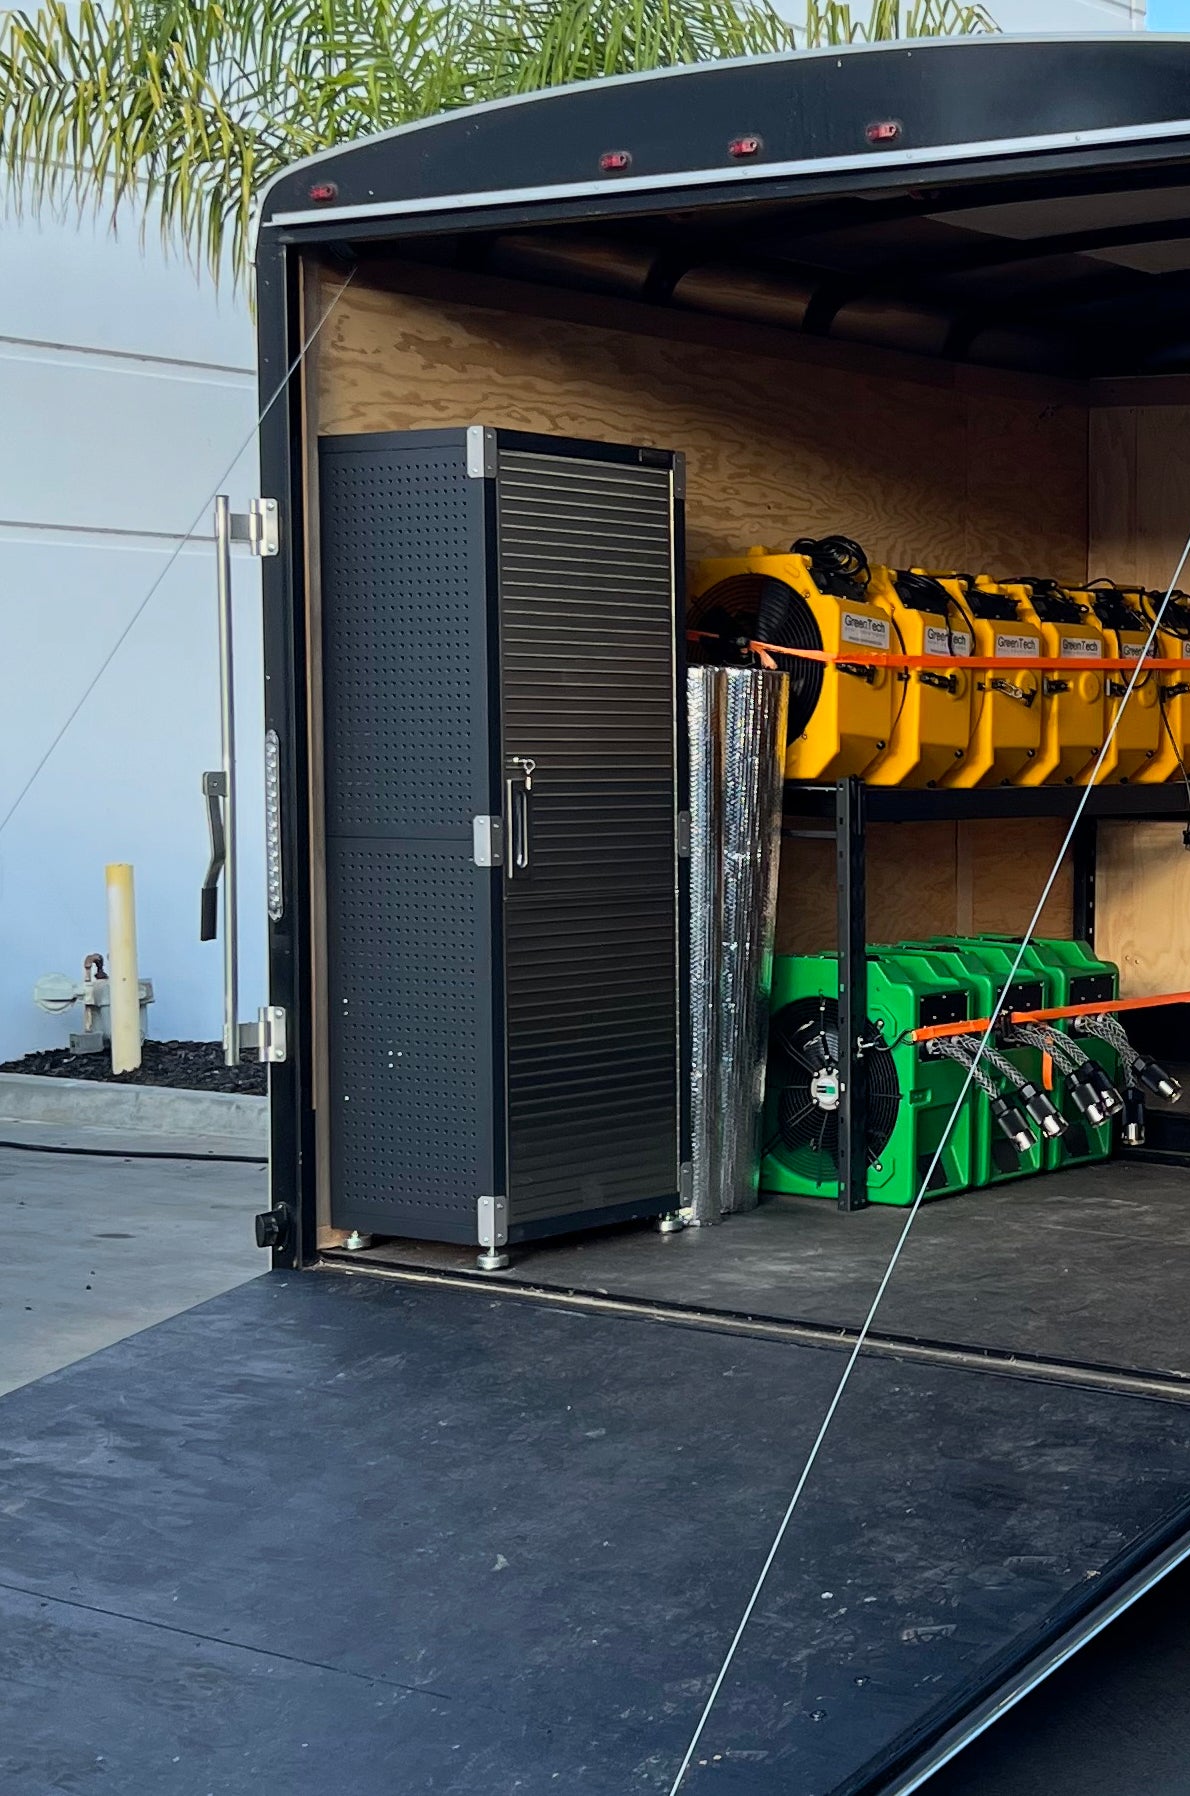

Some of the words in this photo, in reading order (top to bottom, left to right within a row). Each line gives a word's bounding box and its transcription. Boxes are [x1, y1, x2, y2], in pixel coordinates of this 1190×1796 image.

[844, 614, 886, 633] GreenTech
[997, 636, 1036, 650] GreenTech
[1062, 638, 1098, 652] GreenTech
